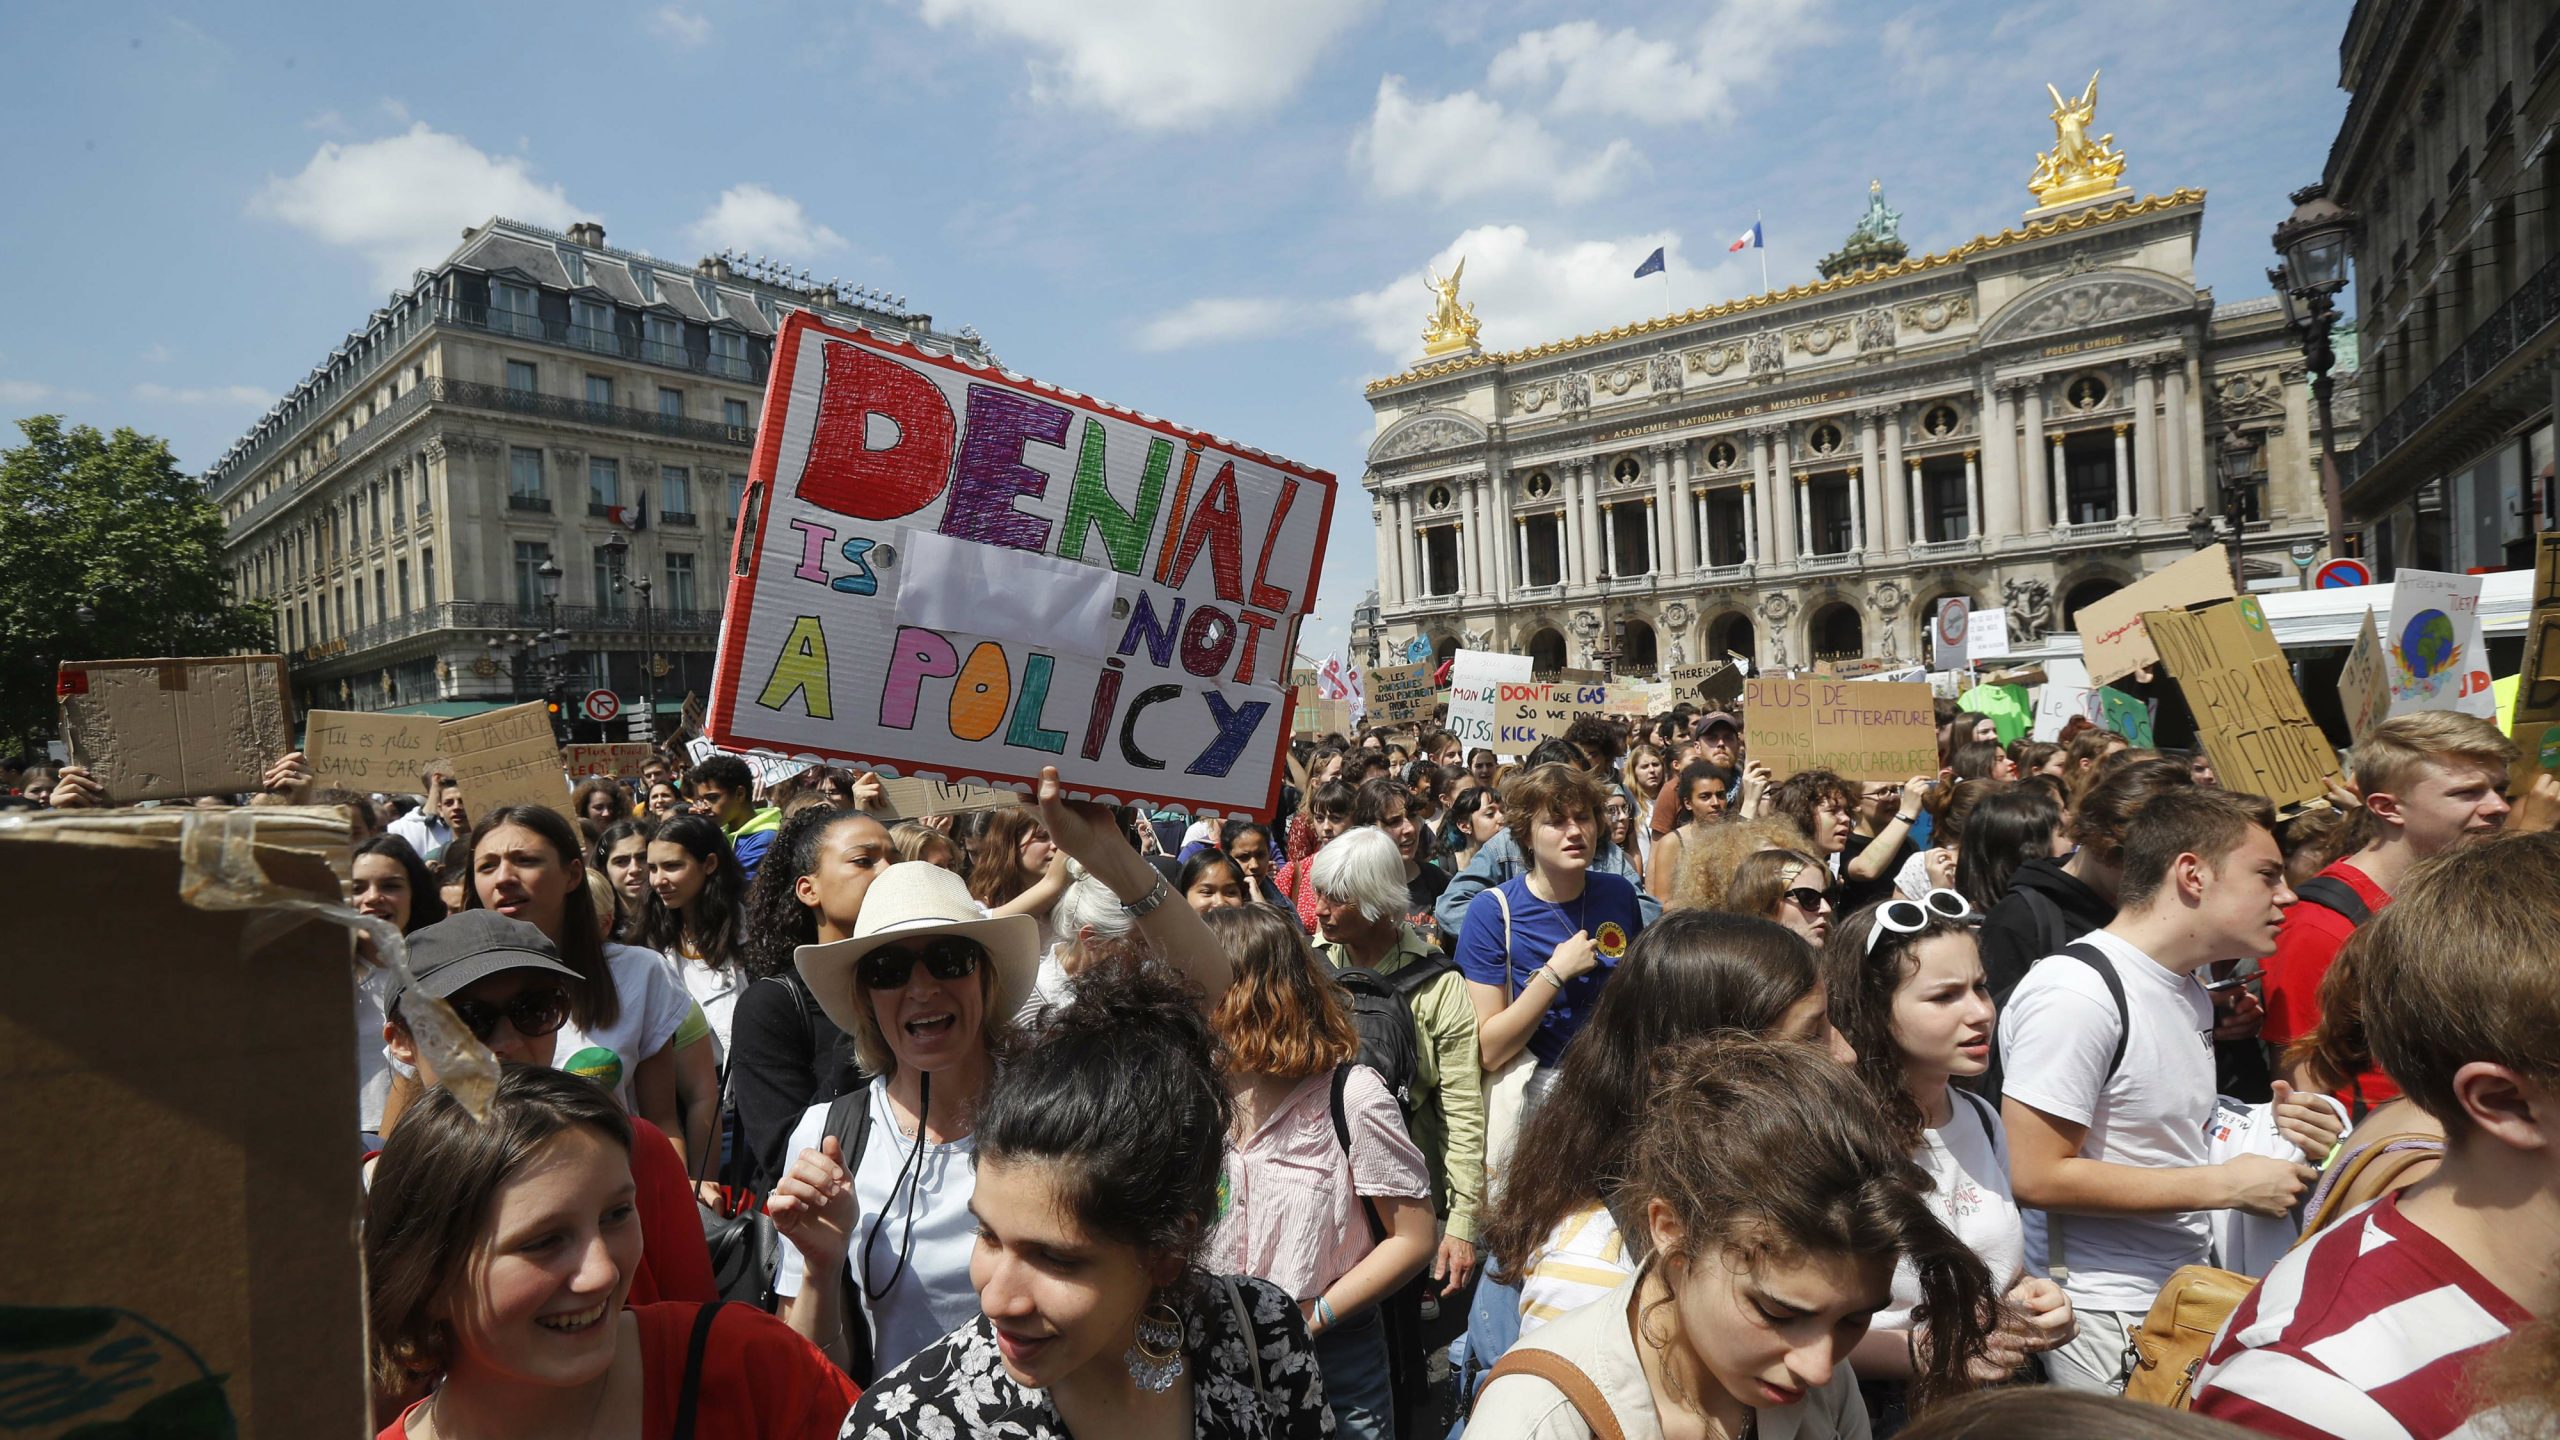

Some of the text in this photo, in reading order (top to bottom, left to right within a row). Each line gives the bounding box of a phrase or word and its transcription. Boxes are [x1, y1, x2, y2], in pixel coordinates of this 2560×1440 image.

[1613, 393, 1829, 439] ACADEMIE NATIONALE DE MUSIQUE
[2292, 544, 2314, 555] BUS
[790, 519, 1276, 685] IS NOT
[756, 616, 834, 720] A
[1390, 672, 1406, 682] LES
[1670, 668, 1703, 681] THERE
[1453, 687, 1478, 701] MON
[1500, 685, 1554, 702] DON'T
[1553, 692, 1572, 703] USE
[1577, 687, 1605, 704] GAS
[1746, 683, 1848, 708] PLUS DE
[2042, 690, 2063, 718] Le
[1816, 709, 1934, 727] LITTERATURE
[314, 725, 347, 745] Tu
[359, 733, 375, 748] es
[381, 725, 421, 756] plus
[1501, 725, 1537, 742] KICK
[1750, 730, 1812, 748] MOINS
[316, 755, 369, 777] SANS
[1786, 749, 1939, 774] D'HYDROCARBURES
